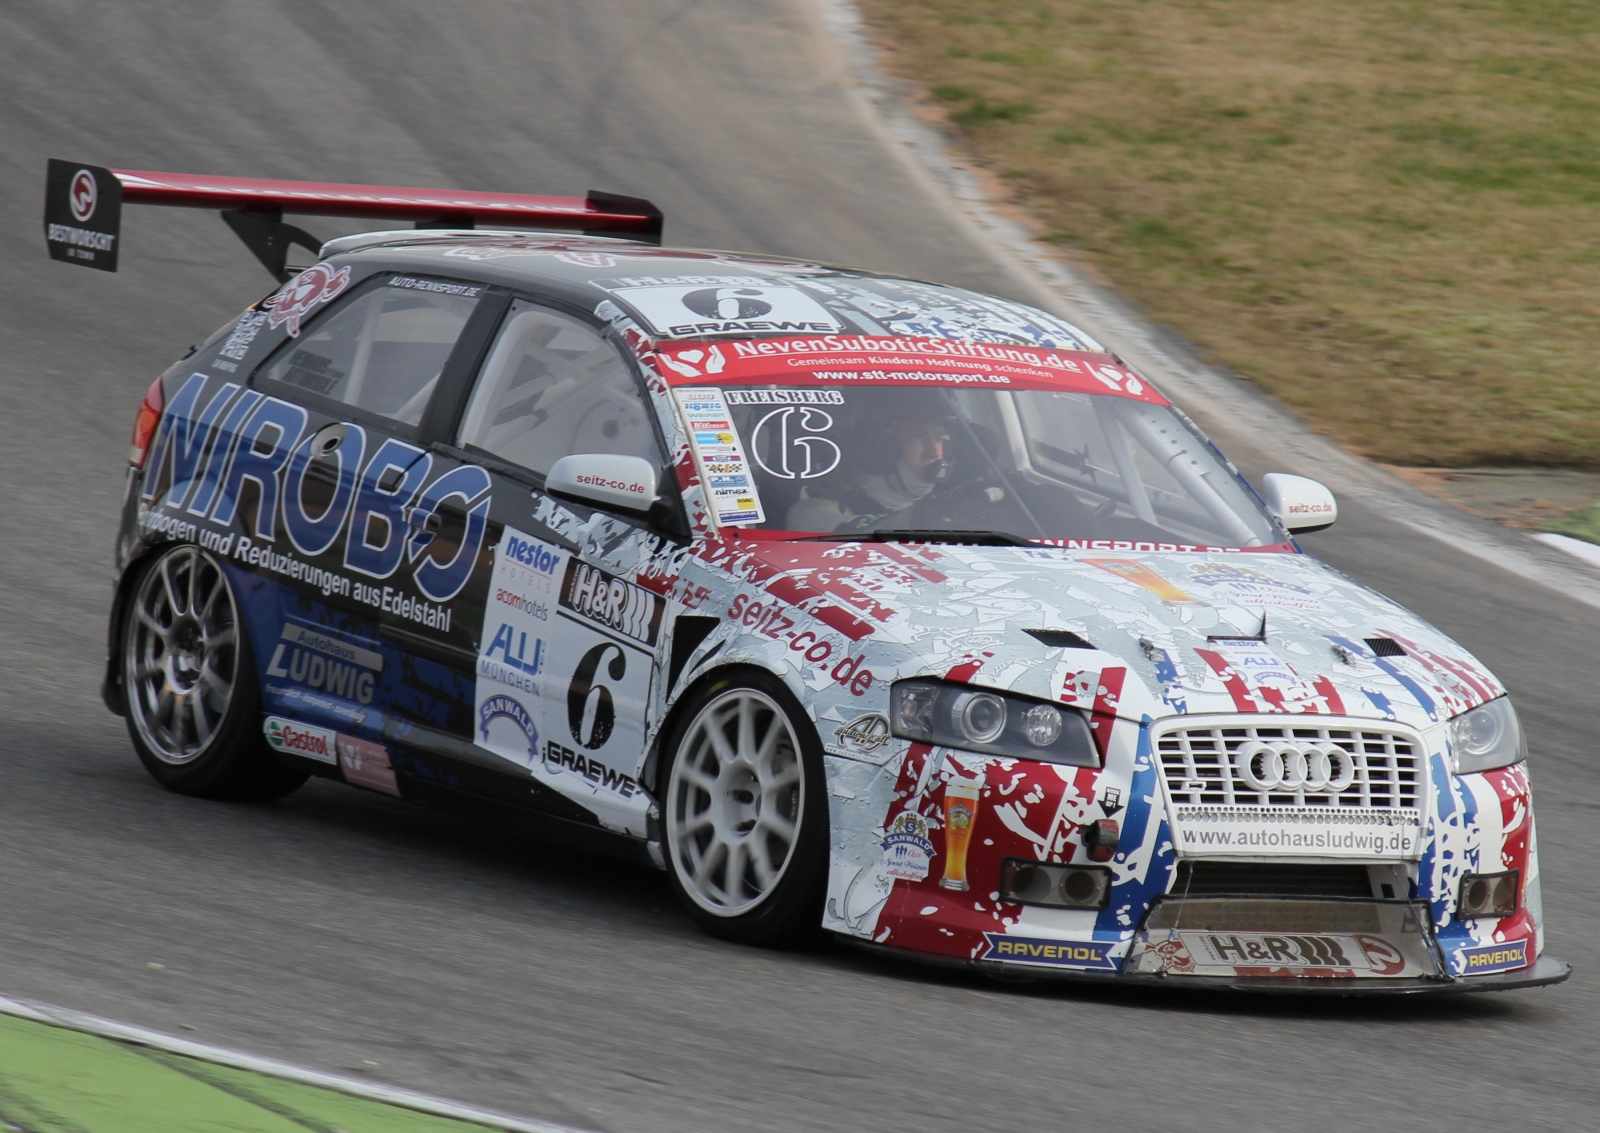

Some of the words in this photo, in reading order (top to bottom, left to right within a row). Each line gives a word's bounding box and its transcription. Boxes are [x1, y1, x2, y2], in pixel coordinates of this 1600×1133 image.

[388, 276, 481, 297] AUTO-RENNSPORT.DE
[682, 287, 773, 320] 6
[669, 321, 833, 335] GRAEWE
[733, 335, 1081, 371] NevenSuboticStiftung.de
[787, 356, 866, 367] Gemeinsam
[868, 356, 923, 366] Kindern
[927, 358, 991, 371] Hoffnung
[995, 364, 1053, 378] schenken
[812, 369, 1011, 384] www.stt-motorsport.de
[725, 391, 844, 404] FREISBERG
[751, 406, 841, 479] 6
[576, 475, 645, 494] seitz-co.de
[1289, 500, 1333, 513] seitz-co.de
[505, 536, 561, 576] nestor
[200, 528, 235, 556] und
[234, 536, 350, 596] Reduzierungen
[353, 582, 380, 607] aus
[381, 586, 452, 633] Edelstahl
[501, 564, 551, 594] HOTELS
[572, 565, 627, 630] H&R
[297, 630, 356, 661] Autohaus
[728, 593, 873, 696] seitz-co.de
[266, 643, 375, 704] LUDWIG
[480, 660, 541, 697] MÜNCHEN
[567, 642, 627, 750] 6
[483, 698, 534, 738] SANWALD
[282, 725, 330, 756] Castrol
[547, 740, 636, 799] GRAEWE
[887, 834, 931, 850] SANWALD
[907, 823, 914, 832] S
[1183, 829, 1411, 853] www.autohausludwig.de
[998, 941, 1102, 961] RAVENOL
[1209, 935, 1299, 961] H&R
[1469, 949, 1523, 967] RAVENOL
